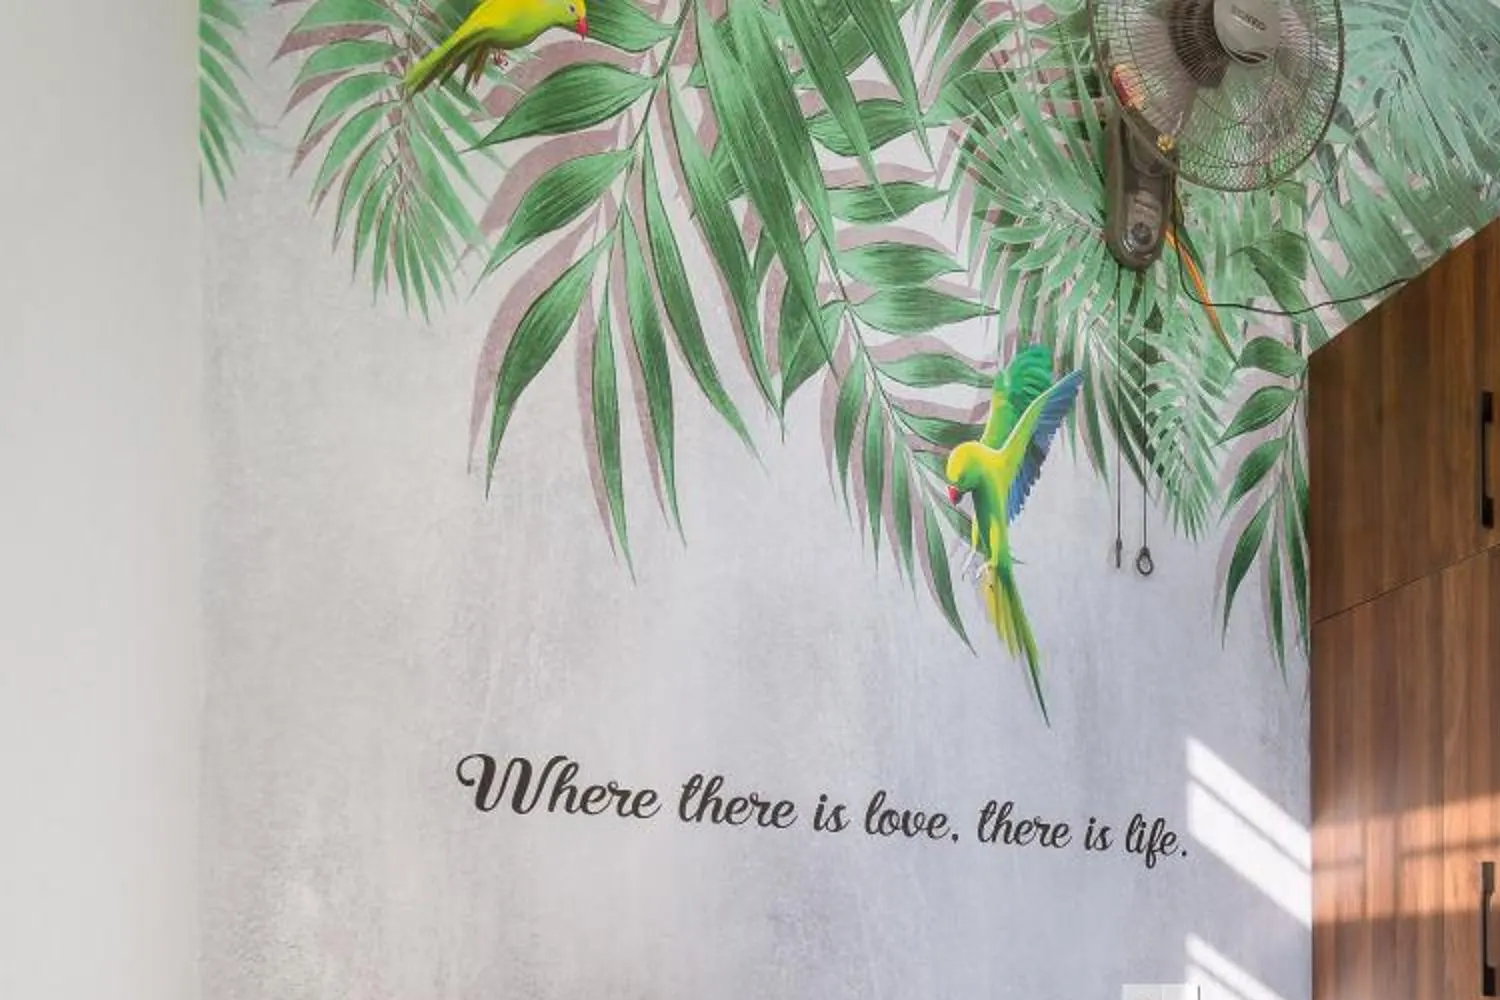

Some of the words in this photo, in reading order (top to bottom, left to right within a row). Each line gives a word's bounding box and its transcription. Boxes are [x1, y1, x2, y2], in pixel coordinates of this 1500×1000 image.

[455, 753, 661, 819] Where
[678, 773, 797, 829] there
[813, 793, 849, 833] is
[977, 799, 1071, 849] there
[1083, 816, 1113, 851] is
[1125, 813, 1188, 870] life.
